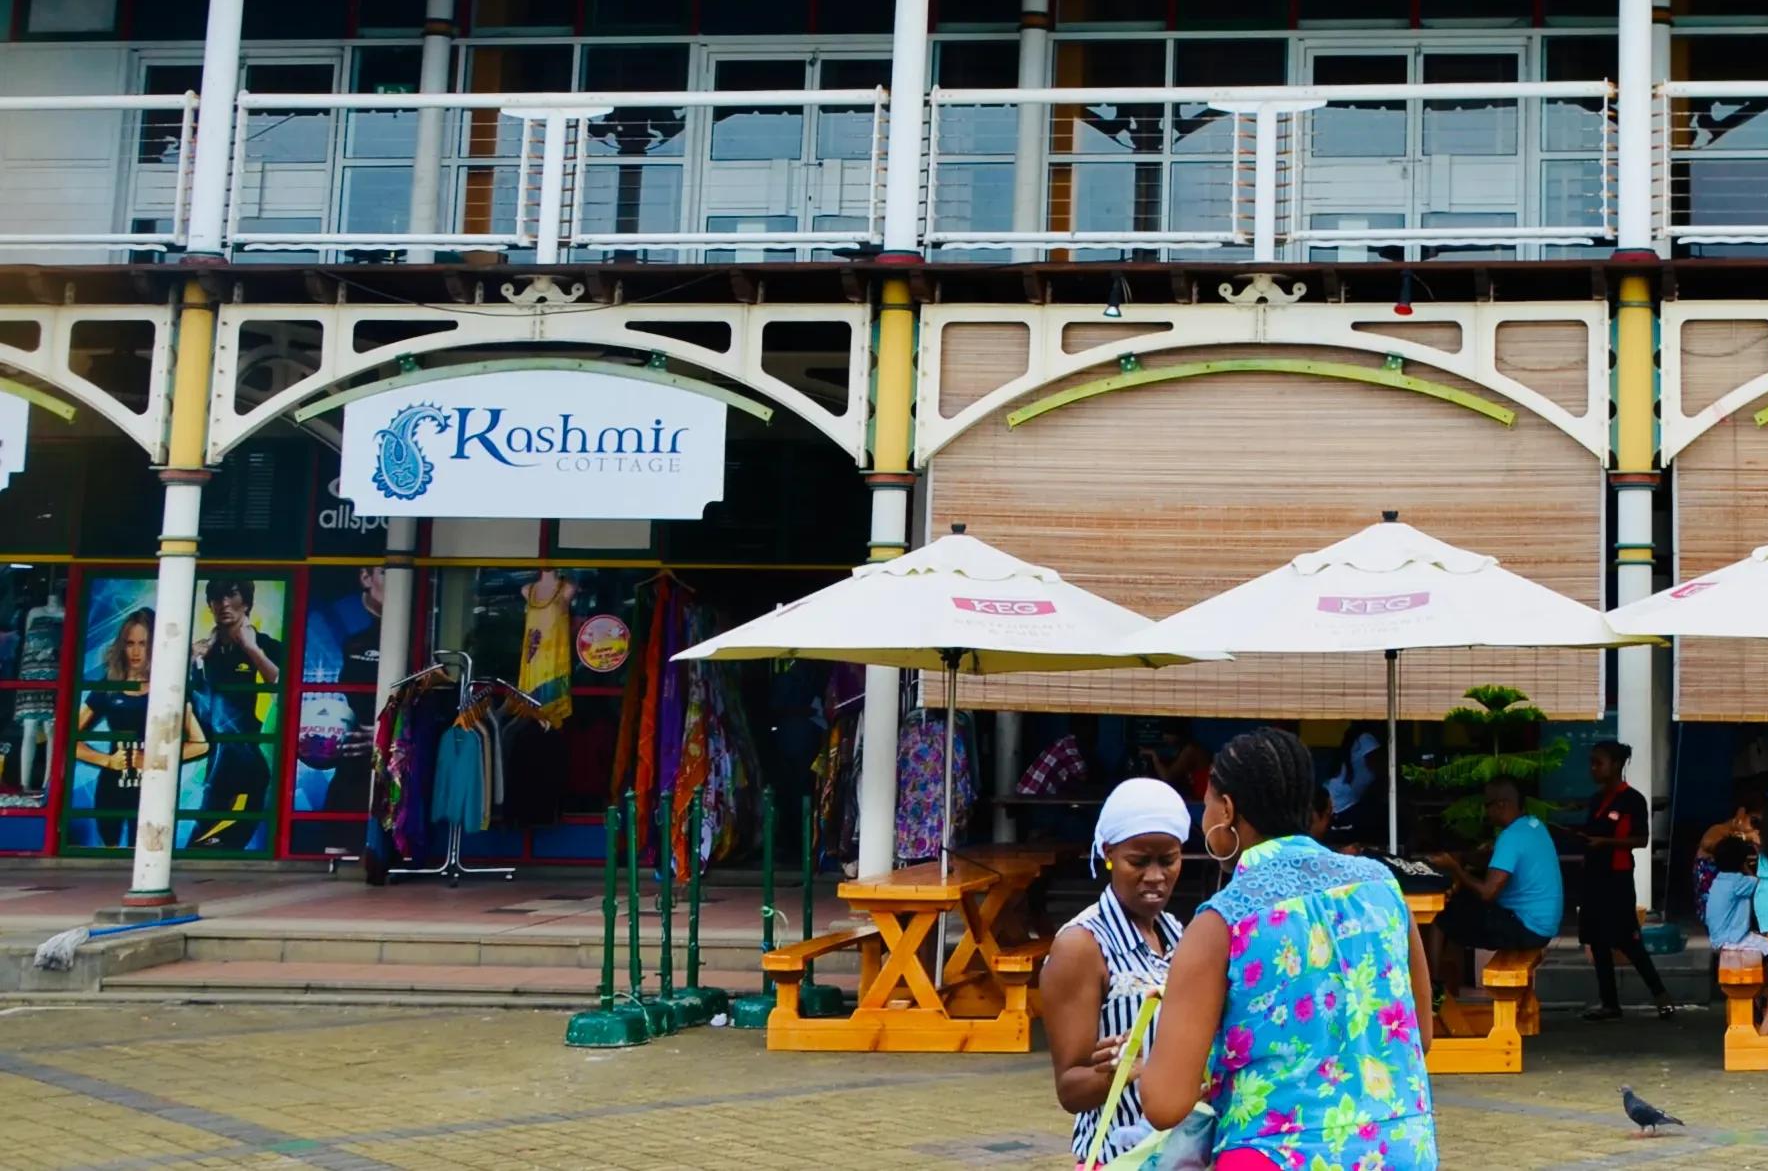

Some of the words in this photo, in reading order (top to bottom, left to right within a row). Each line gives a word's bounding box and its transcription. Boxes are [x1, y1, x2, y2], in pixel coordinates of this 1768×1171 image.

[449, 406, 690, 468] Kashmir
[555, 456, 682, 474] COTTAGE
[969, 599, 1039, 614] KEG
[1340, 596, 1412, 613] KEG
